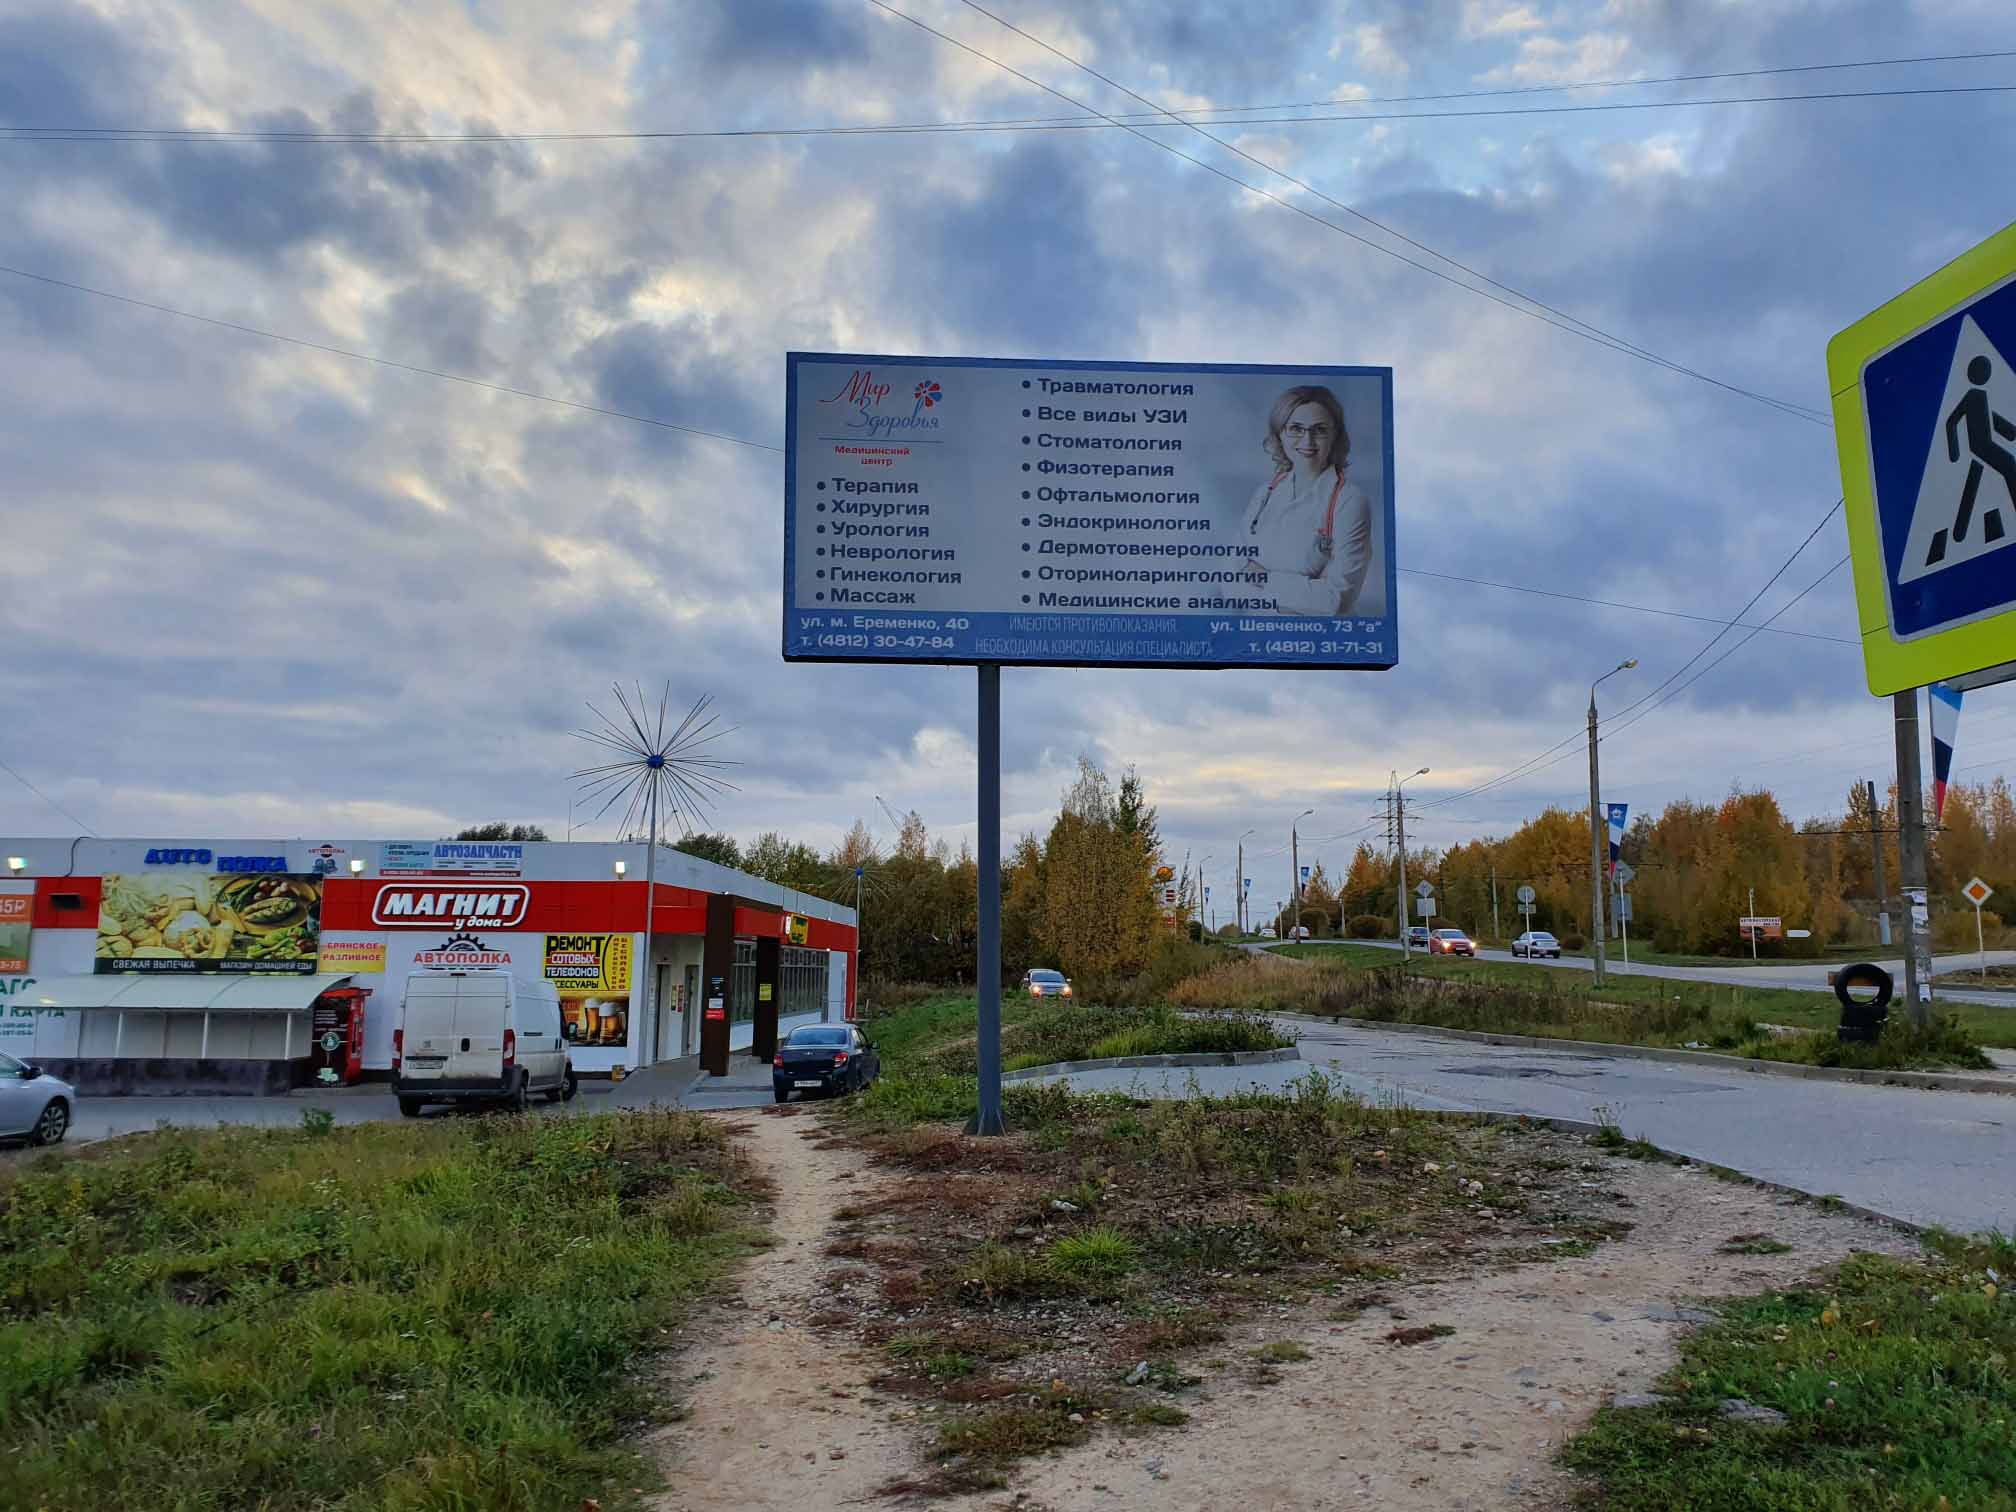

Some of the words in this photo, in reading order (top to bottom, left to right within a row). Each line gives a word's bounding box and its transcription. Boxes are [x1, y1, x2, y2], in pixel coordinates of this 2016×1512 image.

[817, 369, 891, 406] Мир
[1037, 378, 1194, 395] Травматология
[847, 397, 939, 436] Здоровья
[1037, 406, 1076, 421] Все
[1083, 410, 1136, 423] виды
[1143, 409, 1187, 423] УЗИ
[1037, 433, 1182, 450] Стоматология
[834, 445, 911, 456] Медицинский
[861, 457, 893, 466] центр
[1037, 459, 1174, 478] Физотерапия
[831, 477, 919, 495] Терапия
[1037, 486, 1200, 504] Офтальмология
[831, 499, 930, 517] Хирургия
[831, 521, 930, 538] Урология
[1037, 513, 1210, 532] Эндокринология
[831, 543, 955, 561] Неврология
[1037, 539, 1259, 558] Дермотовенерология
[830, 566, 962, 584] Гинекология
[1038, 566, 1268, 584] Оториноларингология
[831, 588, 916, 604] Массаж
[1038, 592, 1180, 609] Медицинские
[1188, 596, 1277, 610] анализы
[800, 617, 824, 629] ул.
[830, 618, 847, 628] м.
[853, 616, 940, 630] Еременко,
[944, 618, 969, 629] 40
[1009, 616, 1061, 632] ИМЕЮТСЯ
[1063, 616, 1176, 633] ПРОТИВОПОКАЗАНИЯ
[1210, 621, 1233, 633] ул.
[1239, 620, 1327, 633] Шевченко,
[1332, 620, 1353, 632] 73
[801, 636, 813, 646] т.
[818, 634, 868, 647] (4812)
[873, 635, 954, 649] 30-47-84
[975, 638, 1049, 655] НЕОБХОДИМА
[1051, 639, 1133, 656] КОНСУЛЬТАЦИЯ
[1136, 640, 1213, 657] СПЕЦИАЛИСТА
[1250, 643, 1261, 653] т.
[1265, 640, 1316, 654] (4812)
[1320, 641, 1383, 654] 31-71-31
[434, 845, 522, 858] АВТОЗАПЧАСТИ
[383, 893, 520, 916] МАГНИТ
[454, 918, 465, 930] у
[467, 916, 502, 927] дома
[546, 935, 606, 957] РЕМОНТ
[113, 959, 150, 969] СВЕЖАЯ
[153, 959, 195, 969] ВЫПЕЧКА
[323, 953, 381, 961] РАЗЛИВНОЕ
[414, 952, 512, 964] АВТОПОЛКА
[551, 953, 595, 964] СОТОВЫХ
[546, 967, 599, 977] ТЕЛЕФОНОВ
[555, 980, 599, 989] СЕССУАРЫ
